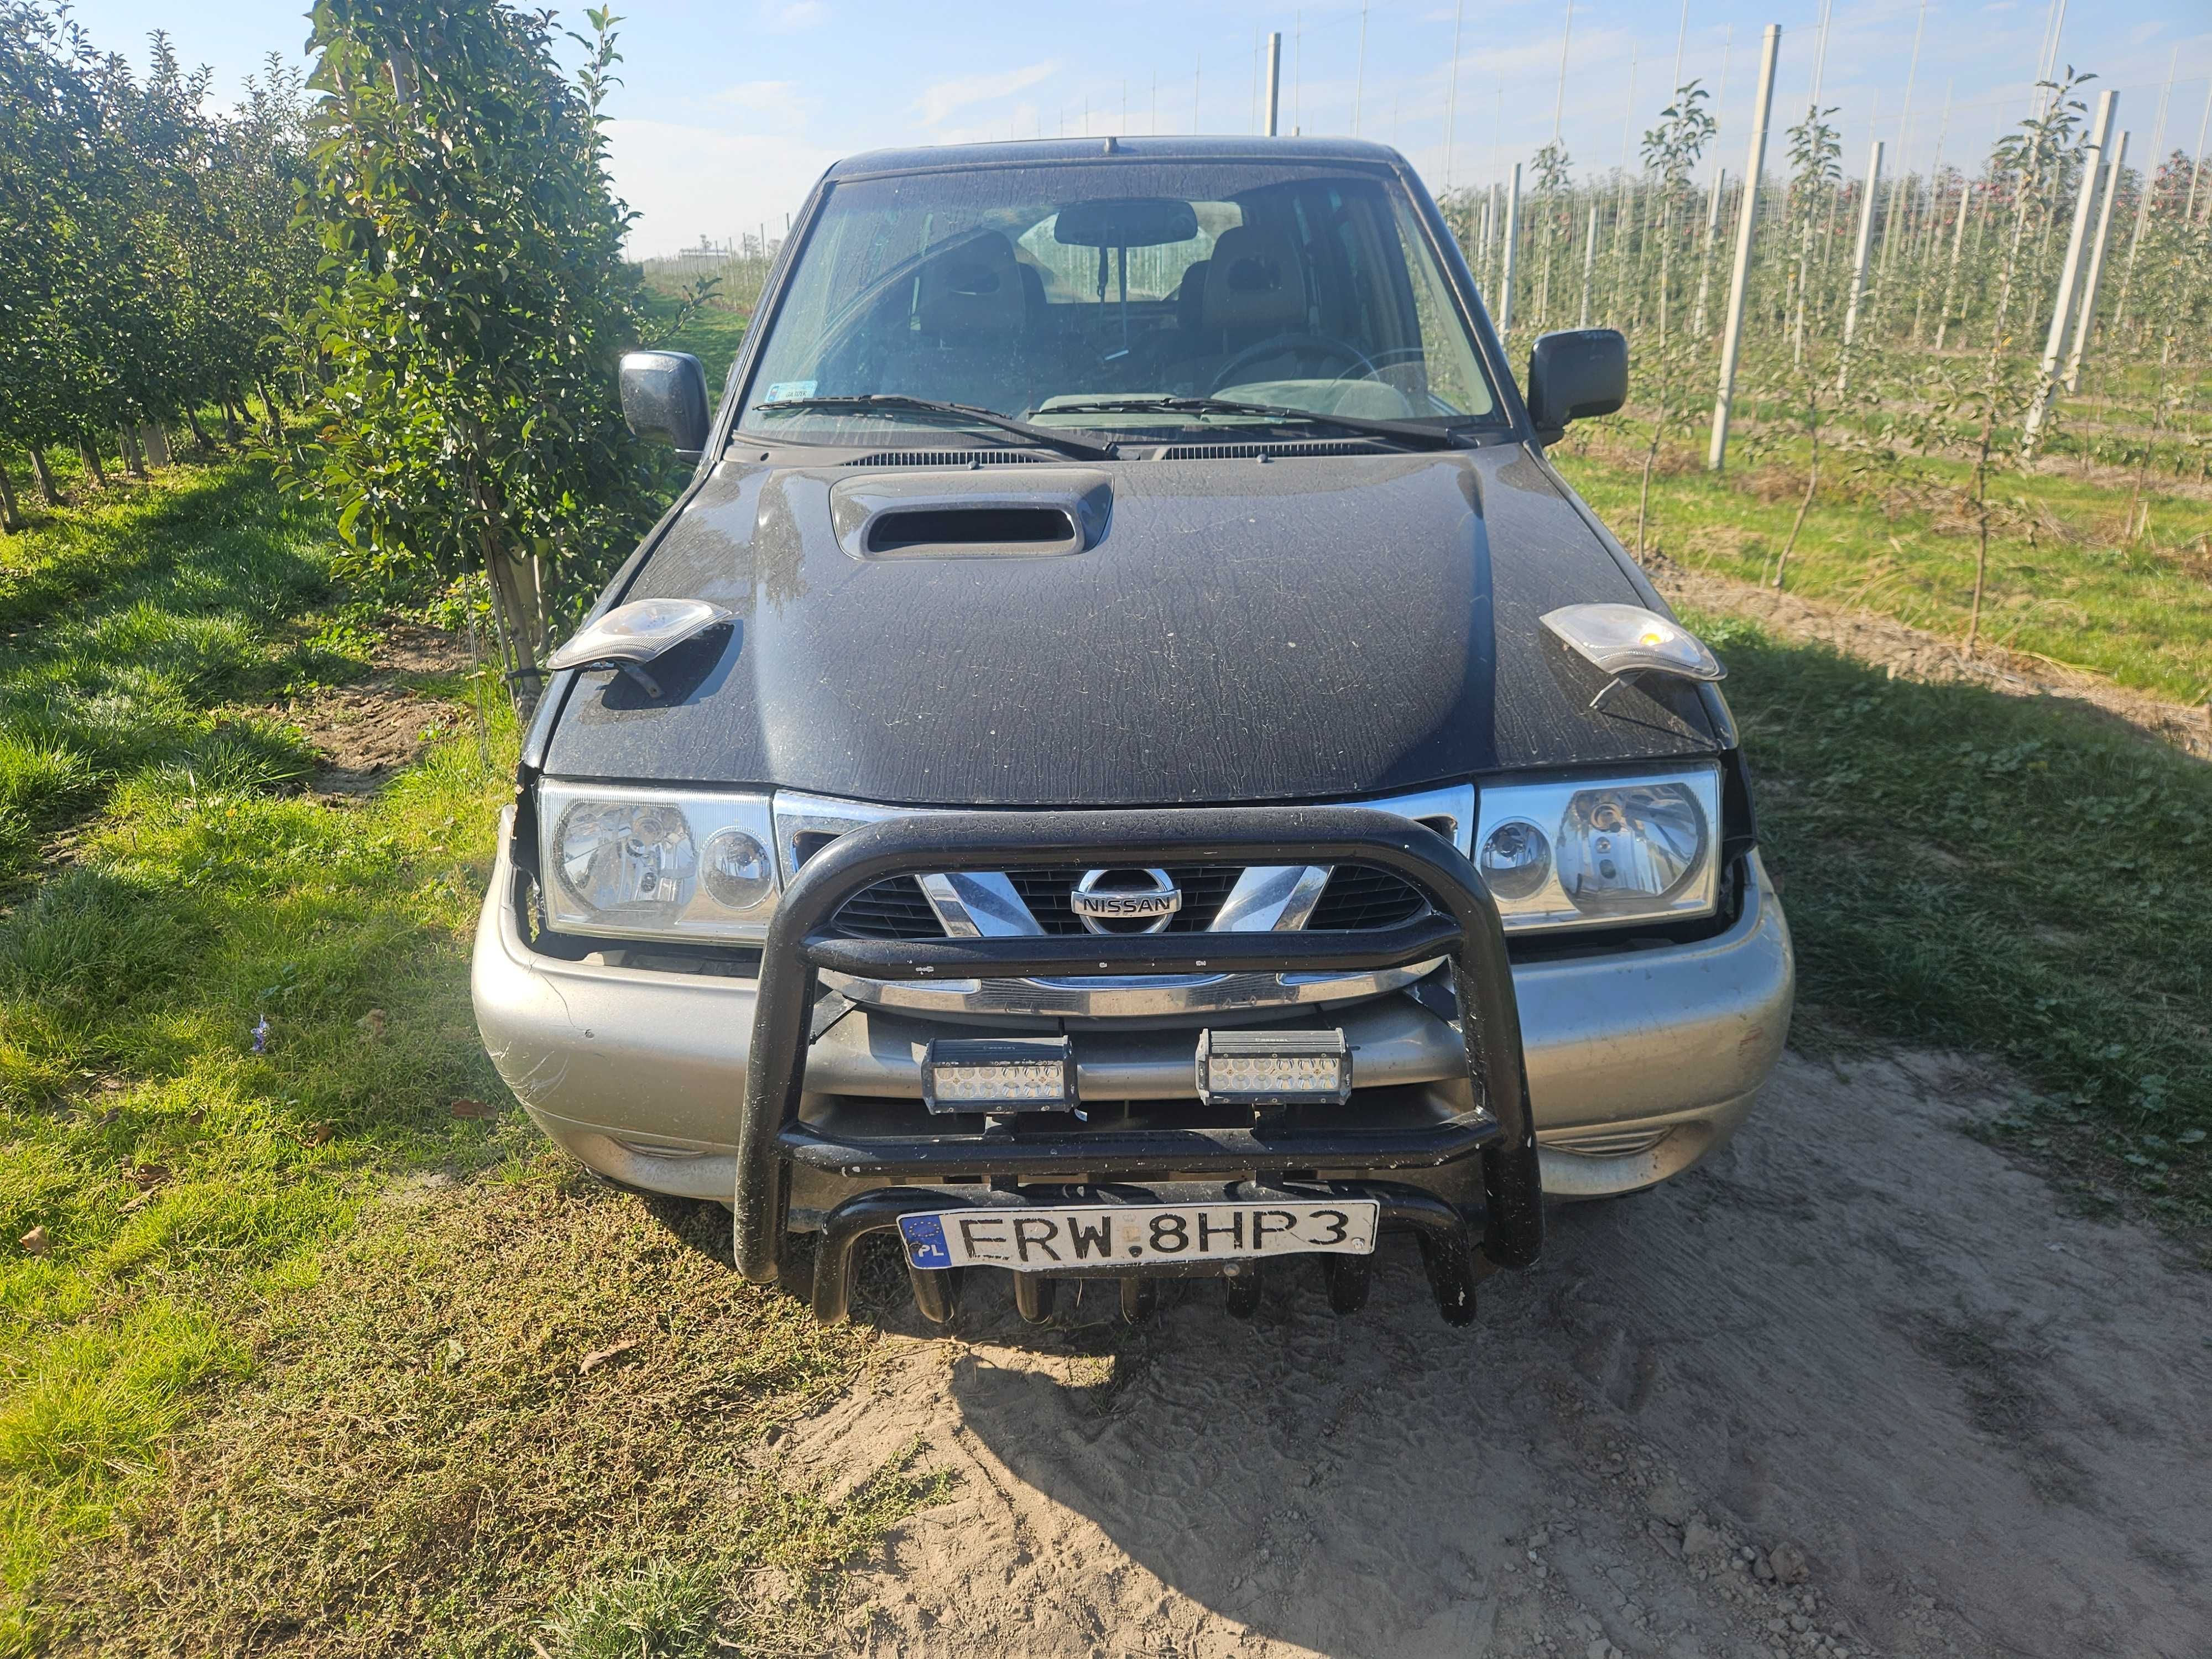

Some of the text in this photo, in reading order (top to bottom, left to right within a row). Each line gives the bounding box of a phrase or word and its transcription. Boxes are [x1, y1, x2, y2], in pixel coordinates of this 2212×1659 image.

[1083, 896, 1171, 913] NISSAN
[959, 1210, 1349, 1262] ERW 8HP3
[919, 1244, 945, 1257] PL
